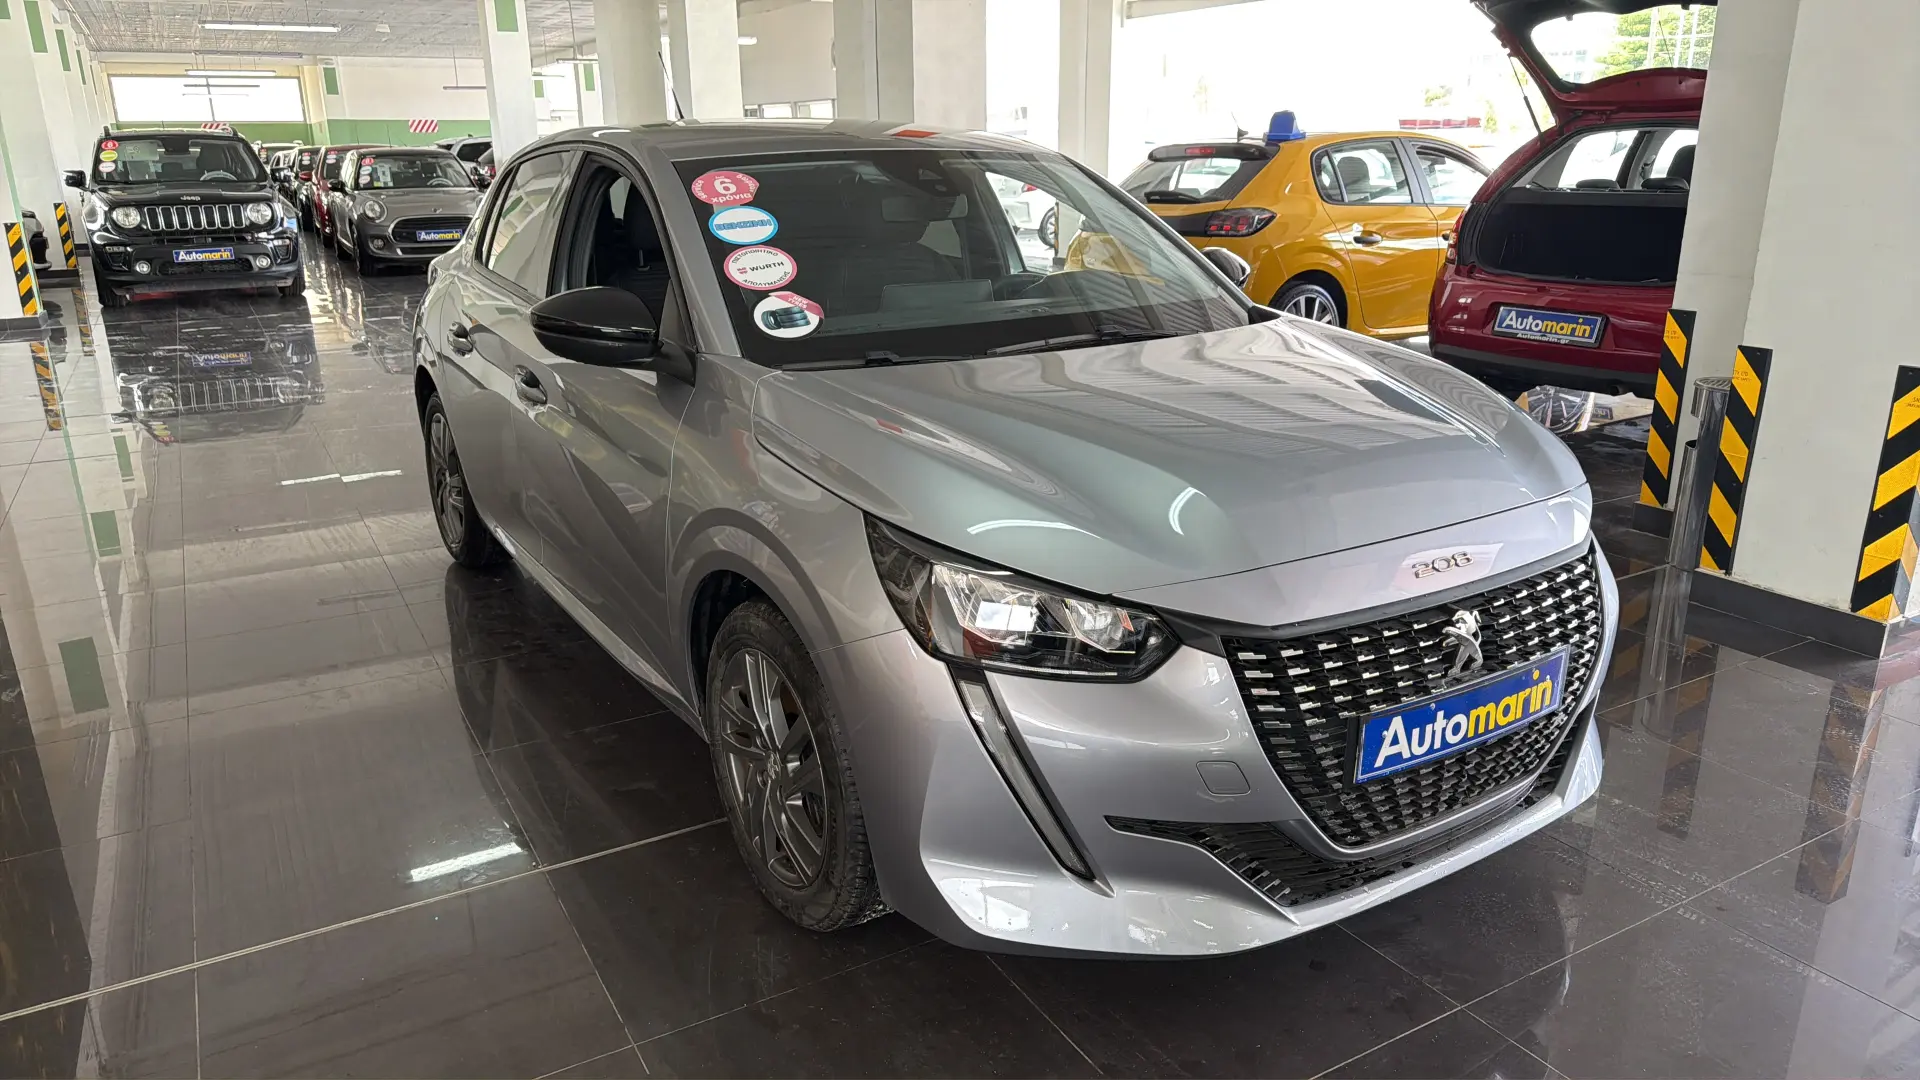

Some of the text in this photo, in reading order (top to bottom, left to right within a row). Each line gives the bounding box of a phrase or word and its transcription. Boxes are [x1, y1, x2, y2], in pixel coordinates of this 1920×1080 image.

[713, 178, 737, 195] 6
[710, 193, 752, 203] χρόνια
[421, 230, 461, 240] Automarin
[179, 248, 231, 261] Automarin
[1502, 310, 1591, 338] Automarin
[1516, 332, 1570, 344] Automarin.gr
[1411, 551, 1474, 579] 208
[1374, 669, 1553, 768] Automarin
